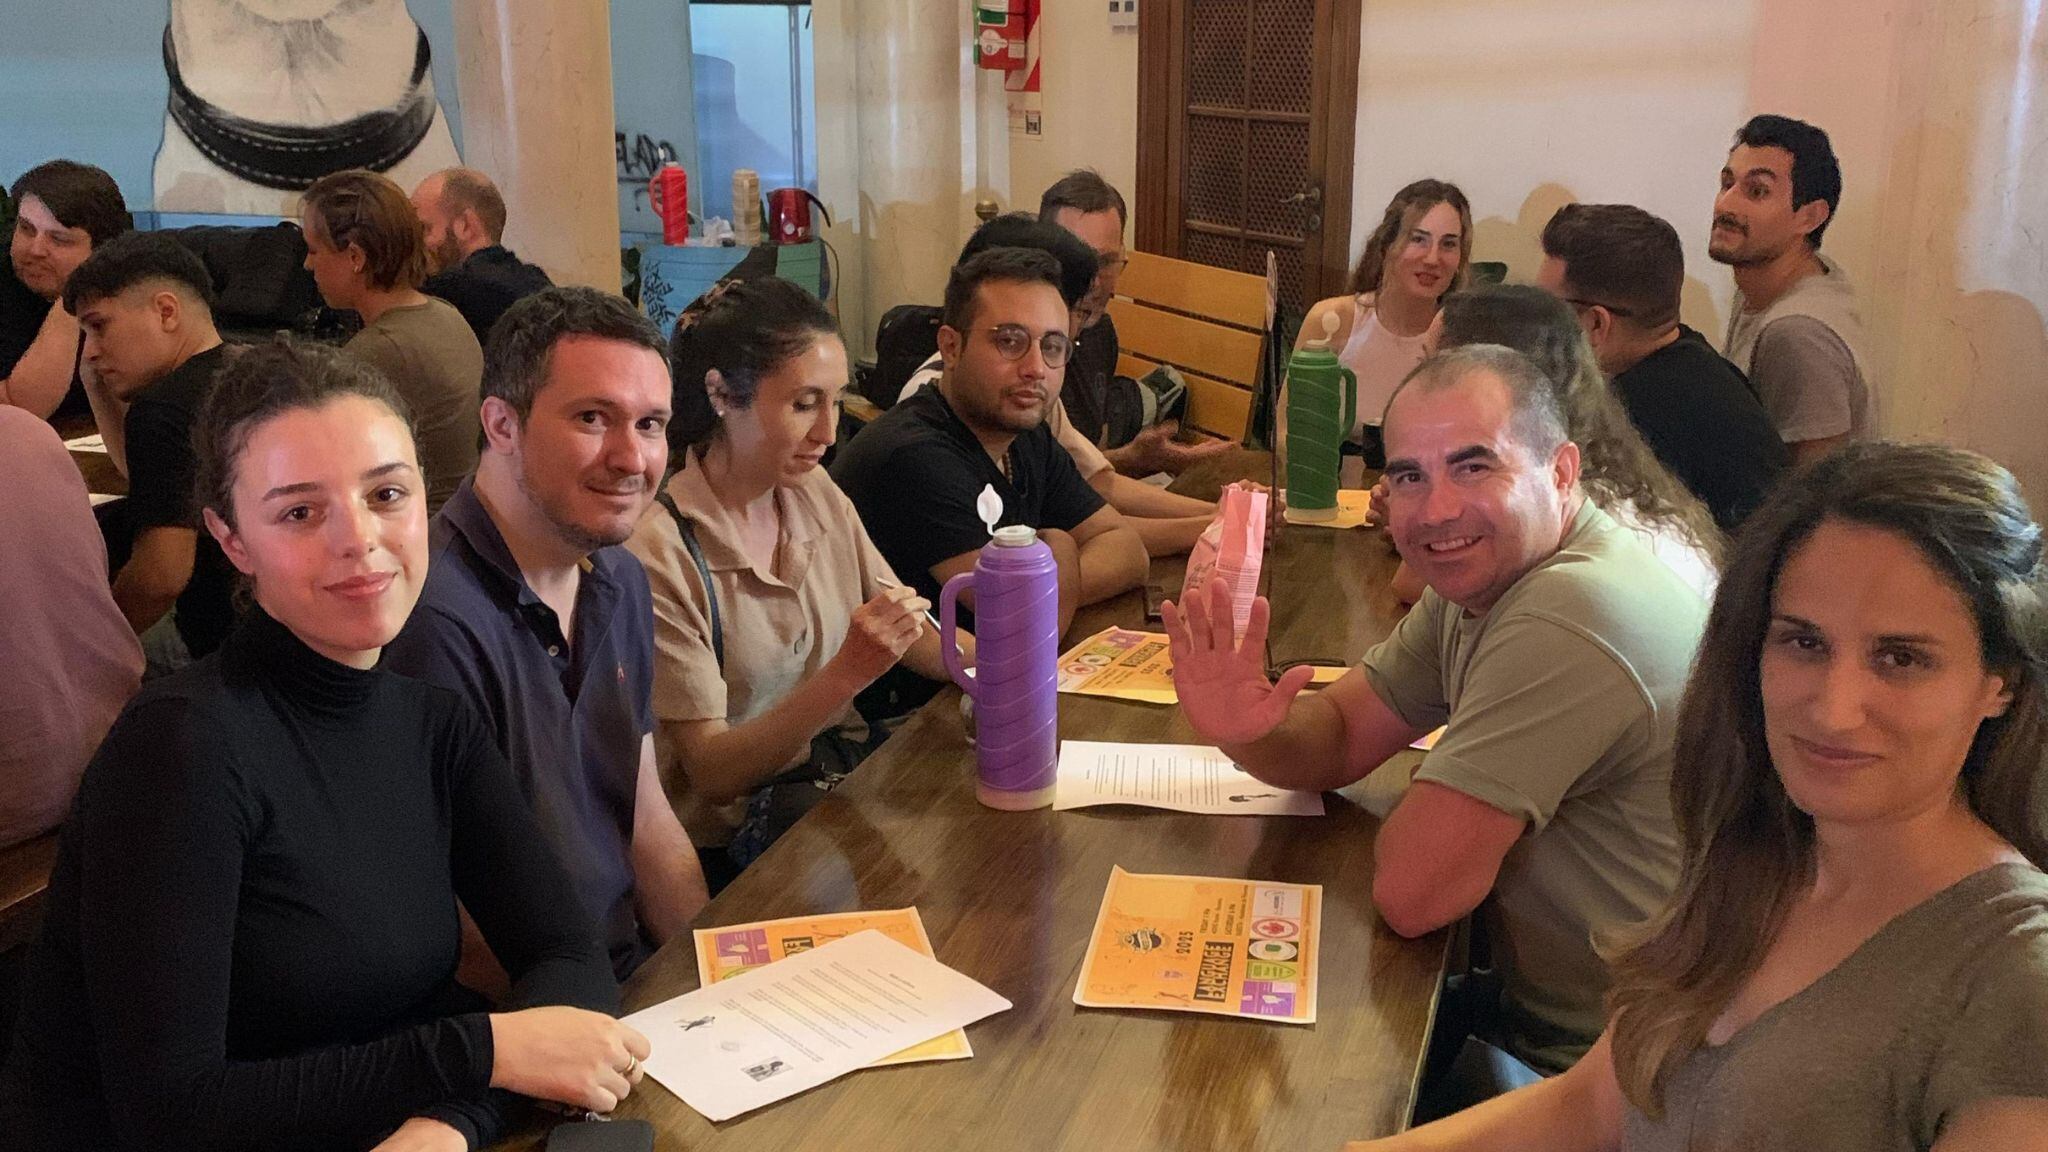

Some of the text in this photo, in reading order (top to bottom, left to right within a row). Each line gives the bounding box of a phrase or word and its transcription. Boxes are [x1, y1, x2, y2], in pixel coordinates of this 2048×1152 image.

[1176, 931, 1194, 954] 2025
[1197, 944, 1218, 998] LANGUAGE
[1210, 945, 1232, 1000] EXCHANGE
